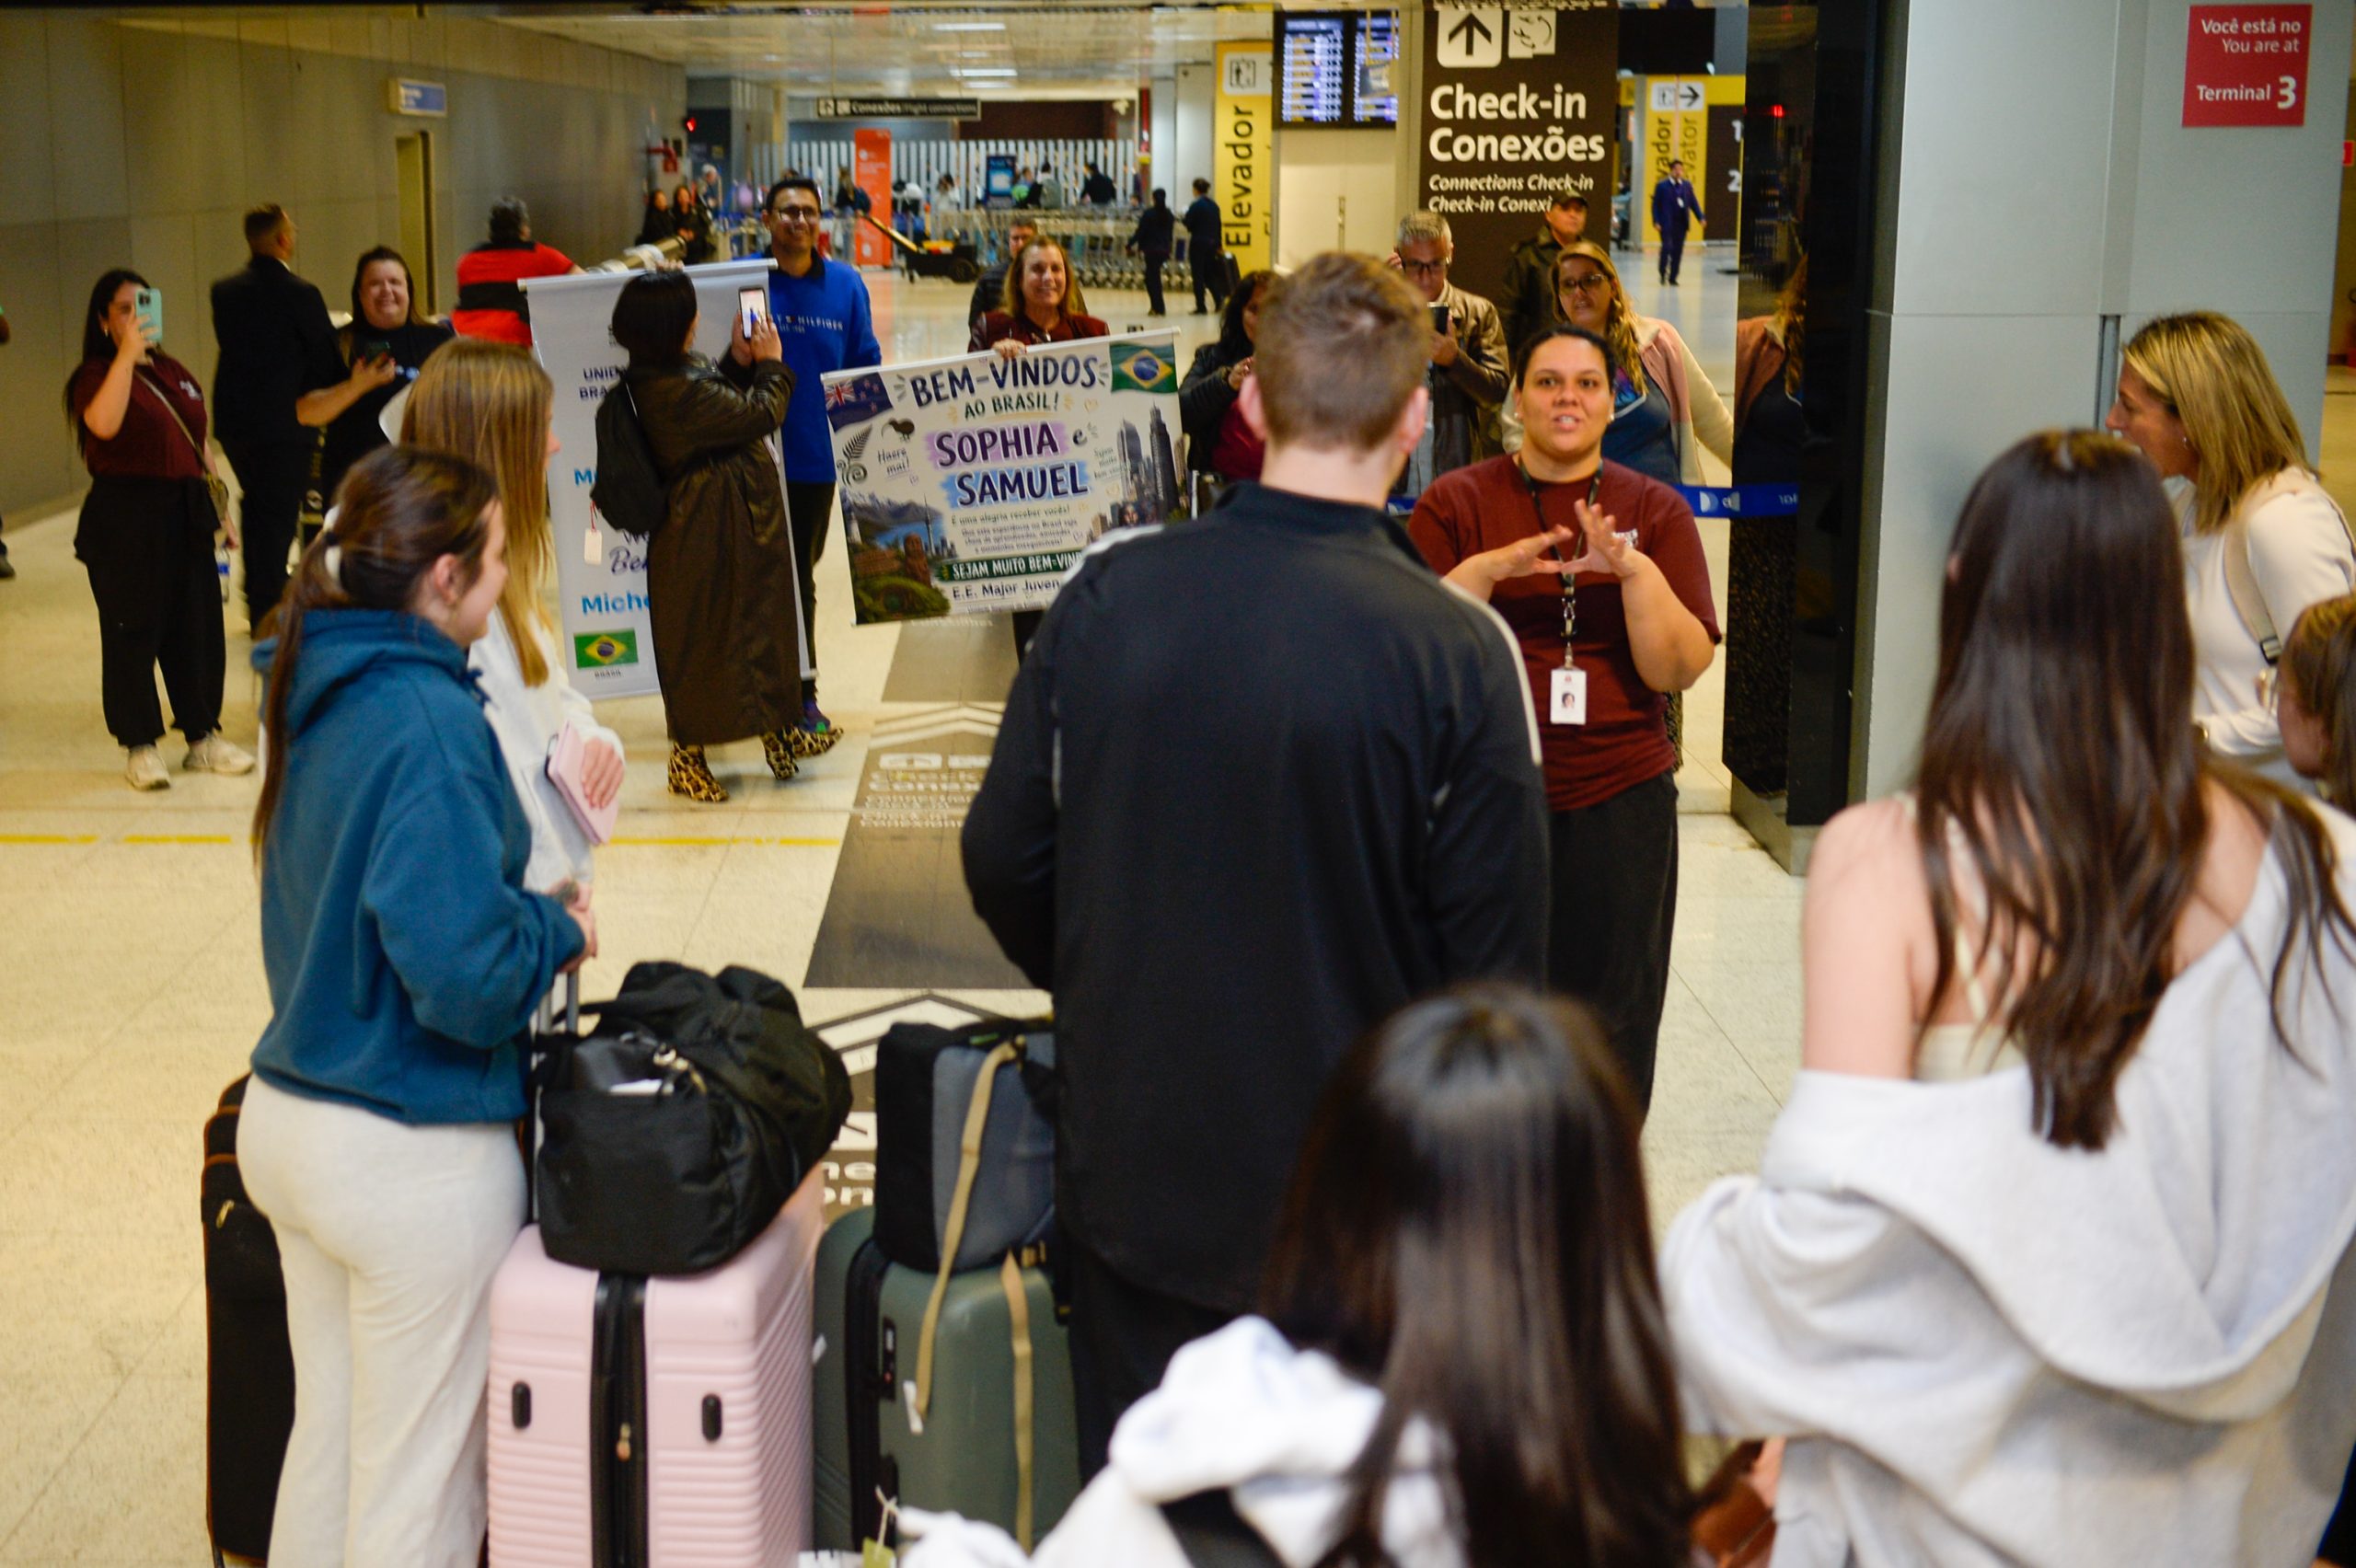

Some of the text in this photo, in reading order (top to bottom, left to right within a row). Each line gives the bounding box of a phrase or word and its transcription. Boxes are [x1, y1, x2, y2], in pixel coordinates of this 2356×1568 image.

[2201, 17, 2301, 34] Você está no
[2223, 38, 2300, 53] You are at
[1430, 83, 1587, 120] Check-in
[2196, 75, 2297, 110] Terminal 3
[1429, 125, 1606, 162] Conexões
[1223, 105, 1253, 247] Elevador
[1428, 173, 1594, 190] Connections Check-in
[1428, 196, 1495, 213] Check-in
[910, 354, 1099, 408] BEM-VINDOS
[964, 392, 1059, 420] AO BRASIL!
[936, 422, 1088, 467] SOPHIA e
[956, 463, 1088, 506] SAMUEL
[953, 560, 989, 582] SEJAM
[992, 557, 1026, 577] MUITO
[981, 580, 1018, 599] Major
